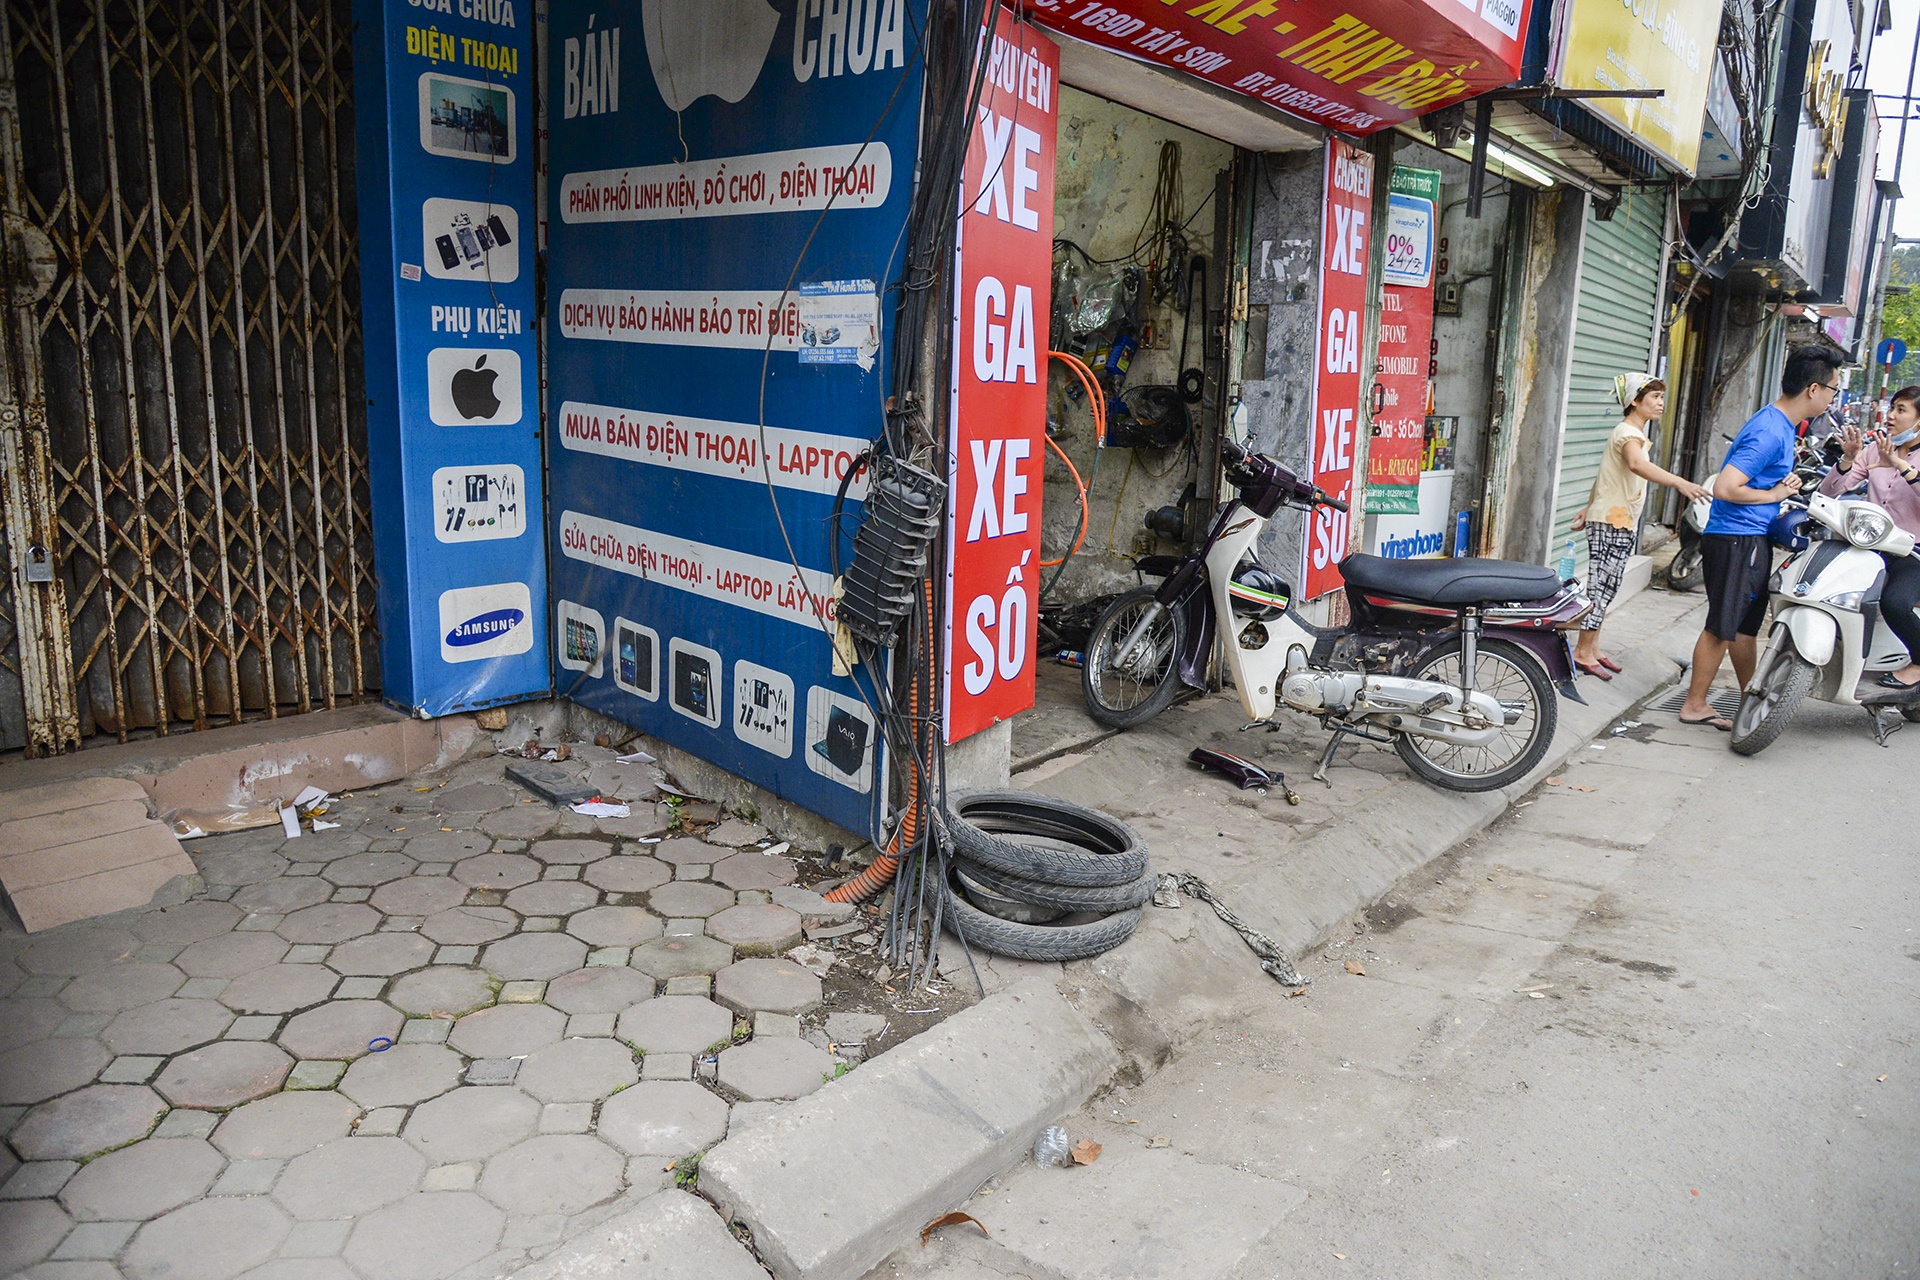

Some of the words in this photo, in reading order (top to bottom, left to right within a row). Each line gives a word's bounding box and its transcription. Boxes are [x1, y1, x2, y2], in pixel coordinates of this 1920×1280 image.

[406, 25, 455, 65] ĐIỆN
[461, 38, 518, 78] THOẠI
[564, 14, 620, 120] BÁN
[1069, 2, 1146, 38] 169D
[1131, 27, 1191, 56] TÂY
[1173, 46, 1232, 74] SƠN
[1276, 13, 1415, 85] THAY
[1686, 38, 1700, 74] GA
[570, 182, 599, 213] PHÂN
[603, 172, 631, 212] PHỐI
[634, 183, 663, 210] LINH
[703, 163, 726, 205] ĐỒ
[780, 161, 817, 206] ĐIỆN
[823, 164, 875, 203] THOẠI
[975, 104, 1041, 233] XE
[1330, 204, 1365, 276] XE
[431, 305, 471, 338] PHỤ
[477, 303, 522, 339] KIỆN
[564, 304, 593, 333] DỊCH
[597, 304, 615, 335] VỤ
[619, 296, 647, 330] BẢO
[652, 301, 694, 333] HÀNH
[700, 297, 732, 335] BẢO
[737, 301, 763, 335] TRÌ
[768, 302, 800, 344] ĐIỆ
[973, 275, 1037, 385] GA
[1326, 308, 1358, 376] GA
[565, 413, 602, 442] MUA
[606, 414, 640, 449] BÁN
[646, 420, 688, 462] ĐIỆN
[695, 432, 756, 474] THOẠI
[1319, 408, 1353, 474] XE
[1371, 454, 1383, 476] LÁ
[1407, 458, 1418, 476] GA
[966, 438, 1031, 543] XE
[1314, 480, 1350, 570] SỐ
[1380, 529, 1443, 558] vinaphone
[564, 522, 587, 551] SỬA
[590, 534, 623, 562] CHỮA
[660, 553, 702, 588] THOẠI
[716, 568, 773, 602] LAPTOP
[777, 575, 810, 612] LẤY
[812, 594, 836, 621] NG
[455, 618, 515, 637] SAMSUNG
[963, 549, 1031, 696] SỐ
[838, 724, 855, 740] VAIO
